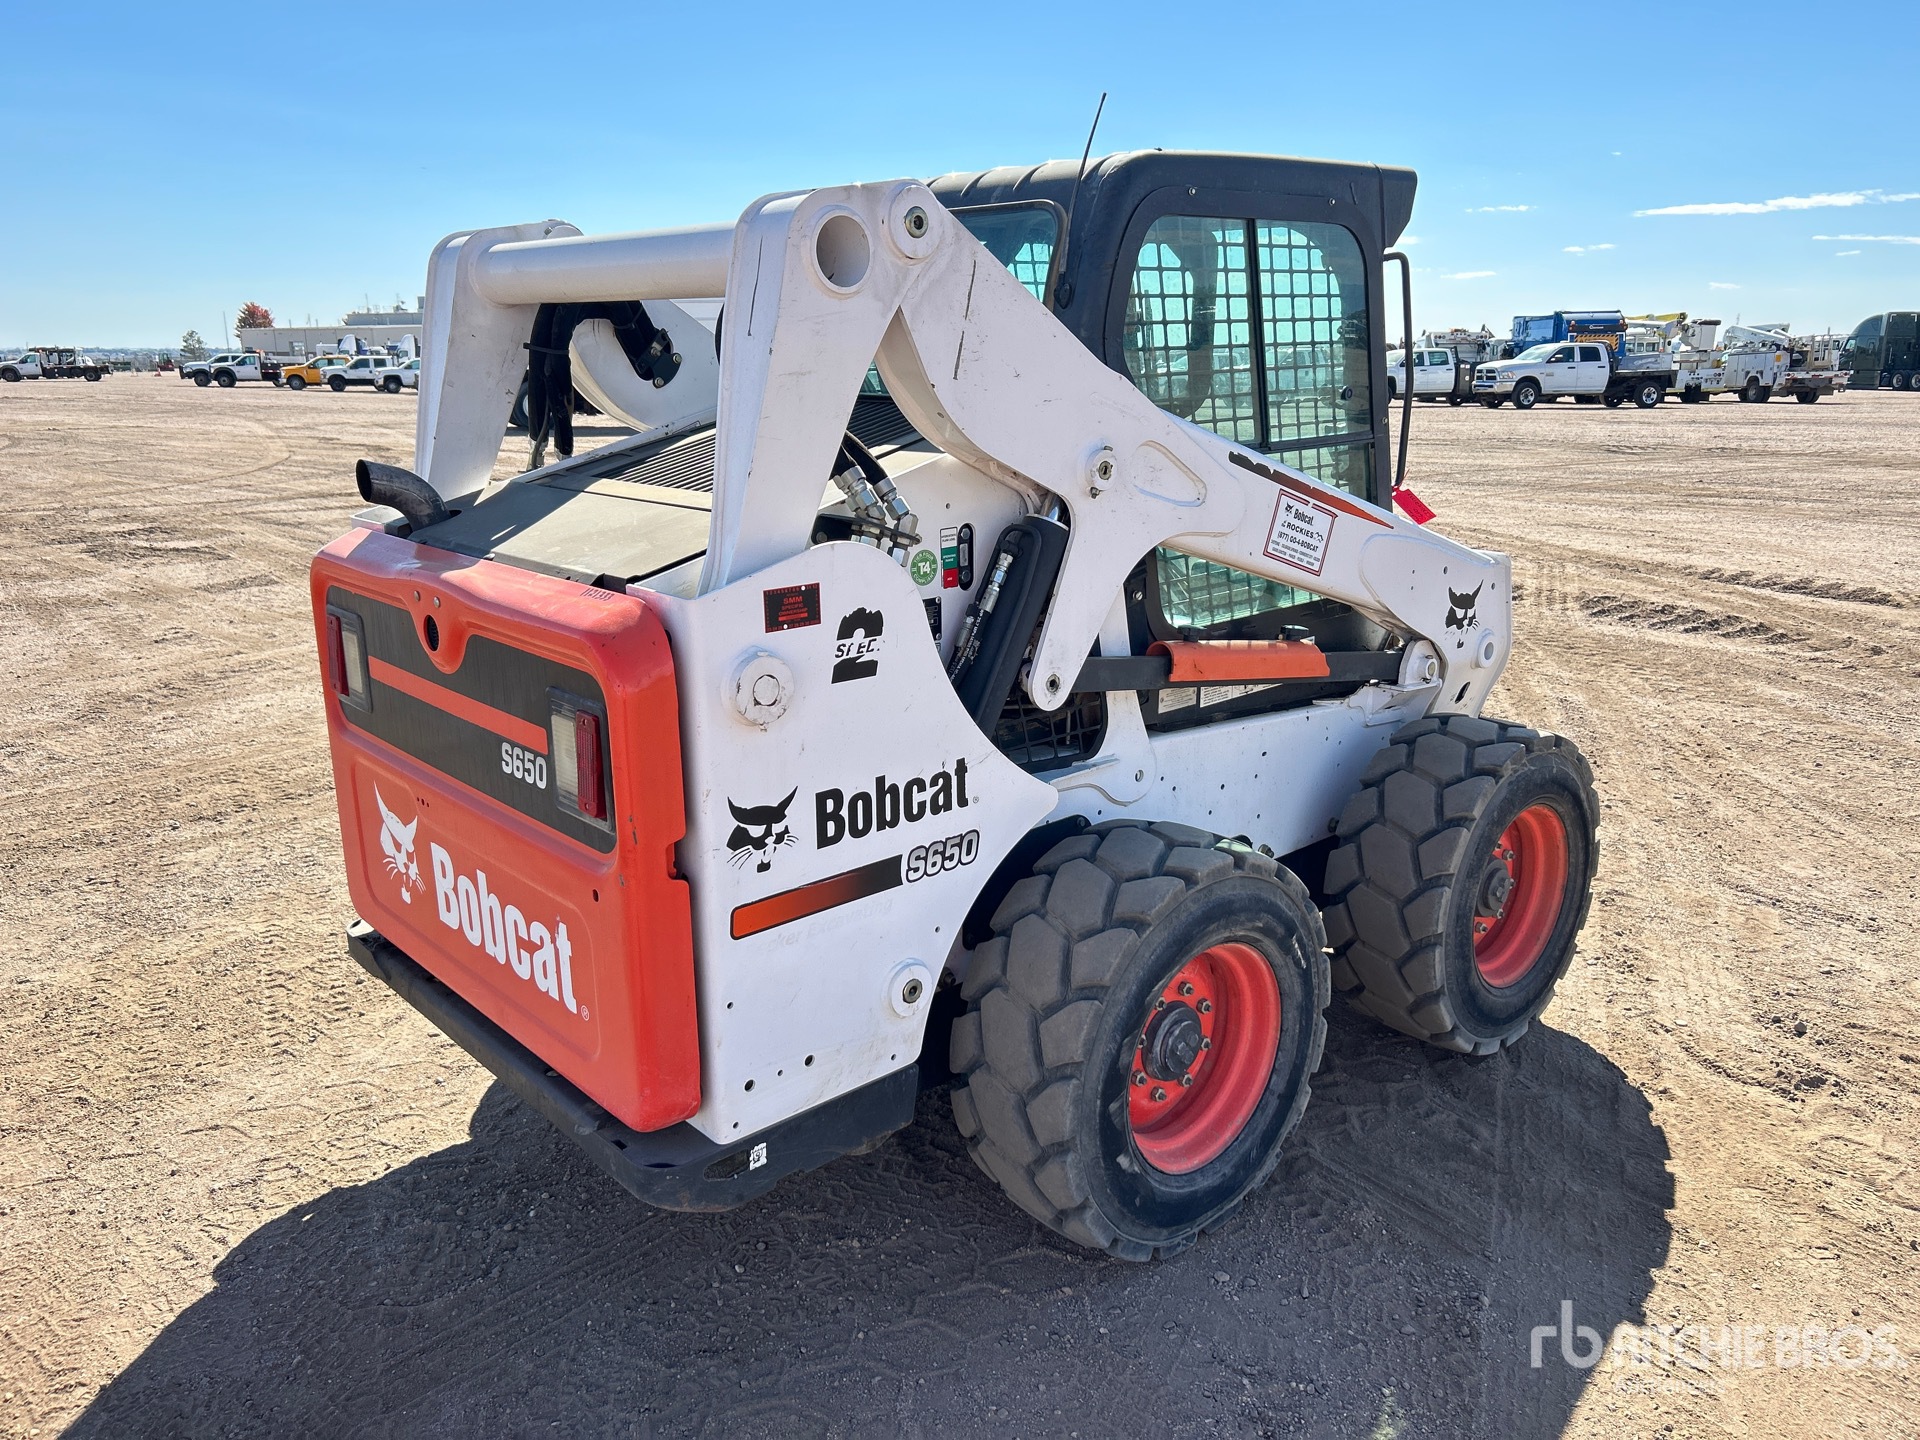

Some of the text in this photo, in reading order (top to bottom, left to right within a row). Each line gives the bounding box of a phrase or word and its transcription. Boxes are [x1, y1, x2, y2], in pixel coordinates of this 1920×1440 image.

[1286, 521, 1314, 539] ROCKIES
[1293, 508, 1314, 526] Bobcat
[917, 561, 931, 575] T4
[783, 595, 803, 604] SMM
[501, 741, 547, 789] S650
[815, 757, 969, 850] Bobcat
[905, 828, 980, 883] S650
[430, 841, 578, 1014] Bobcat
